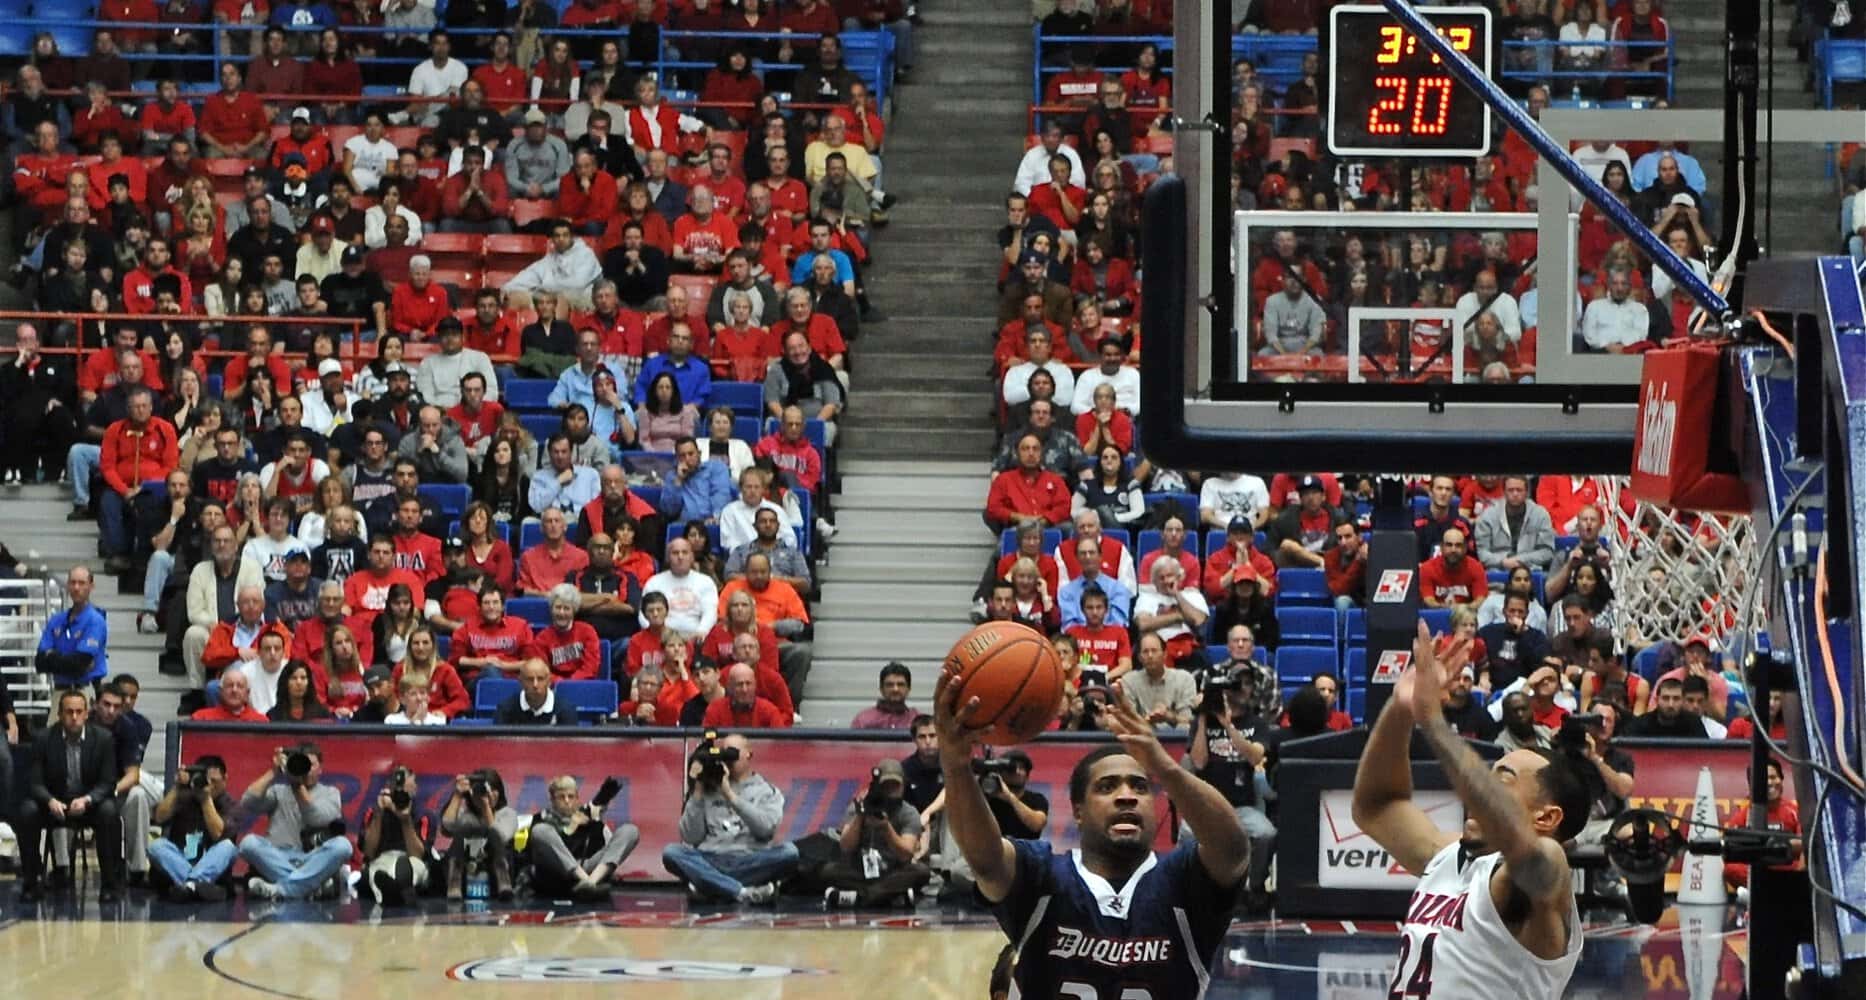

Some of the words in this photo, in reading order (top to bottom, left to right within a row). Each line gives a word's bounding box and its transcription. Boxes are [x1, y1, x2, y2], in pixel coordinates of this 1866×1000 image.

[1368, 77, 1451, 134] 20
[1327, 847, 1408, 874] veri
[1049, 926, 1171, 967] DUQUESNE
